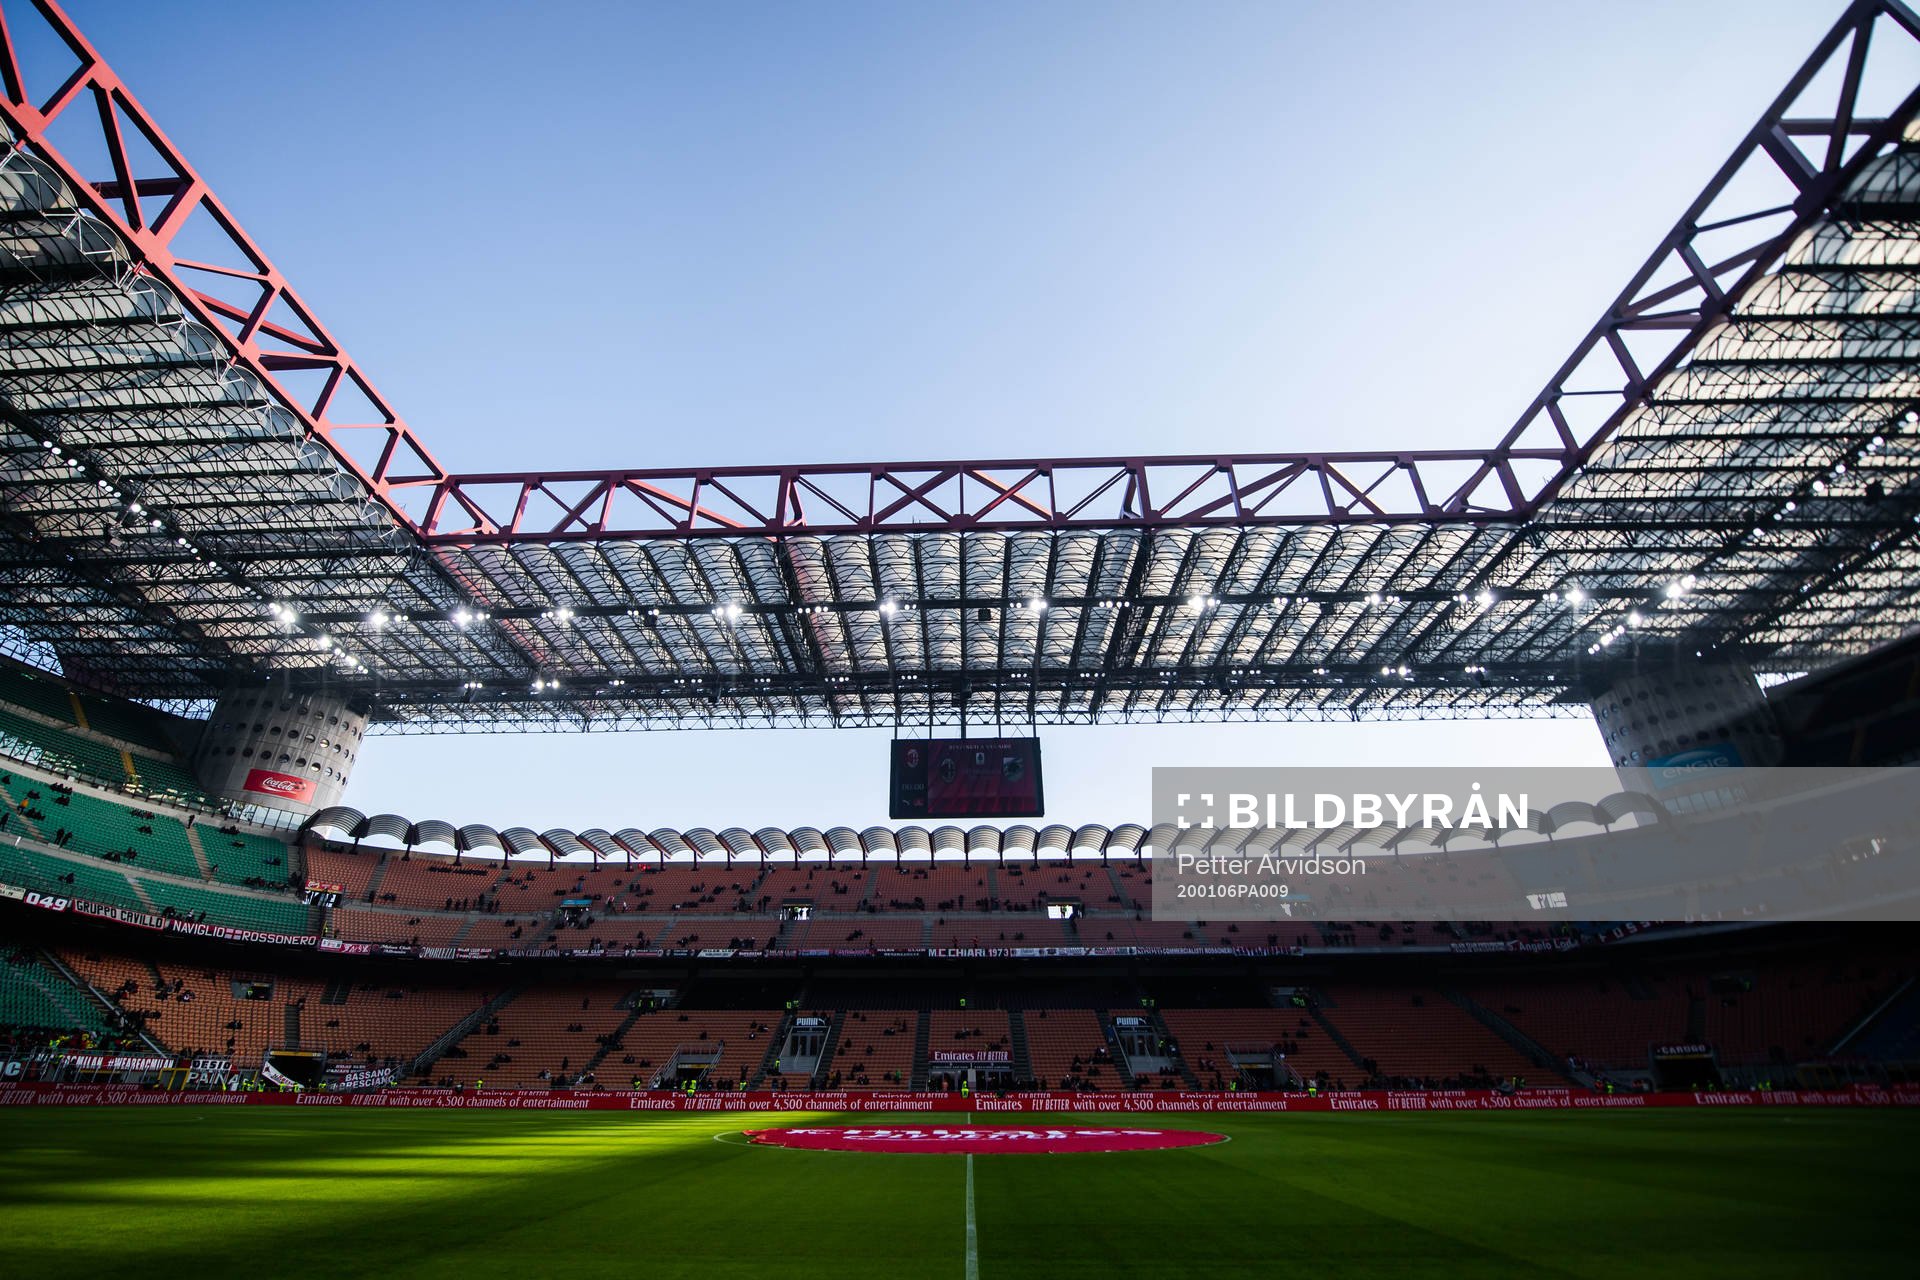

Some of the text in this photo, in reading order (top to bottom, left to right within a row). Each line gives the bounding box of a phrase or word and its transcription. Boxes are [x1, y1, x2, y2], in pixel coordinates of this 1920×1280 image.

[76, 900, 117, 919] GRUPPO
[172, 920, 225, 938] NAVIGLIO
[242, 931, 317, 946] ROSSONERO
[988, 948, 1009, 957] 1973
[796, 1017, 818, 1026] PUMA
[1116, 1017, 1139, 1025] PUMA
[934, 1051, 1008, 1061] Emirates FLY BETTER
[192, 1060, 231, 1070] DESIO
[345, 1068, 391, 1082] BASSANO
[38, 1091, 64, 1104] with
[67, 1094, 93, 1104] over
[96, 1092, 127, 1104] 4,500
[128, 1093, 170, 1103] channels
[173, 1092, 185, 1103] of
[183, 1093, 247, 1103] entertainment
[296, 1094, 589, 1109] Emirates FLY BETTER with over 4,500 channels of entertainment
[1330, 1096, 1644, 1109] Emirates FLY BETTER with over 4,500 channels of entertainment
[631, 1098, 932, 1112] Emirates FLY BETTER with over 4,500 channels of entertainment
[976, 1099, 1286, 1112] Emirates FLY BETTER with over 4,500 channels of entertainment
